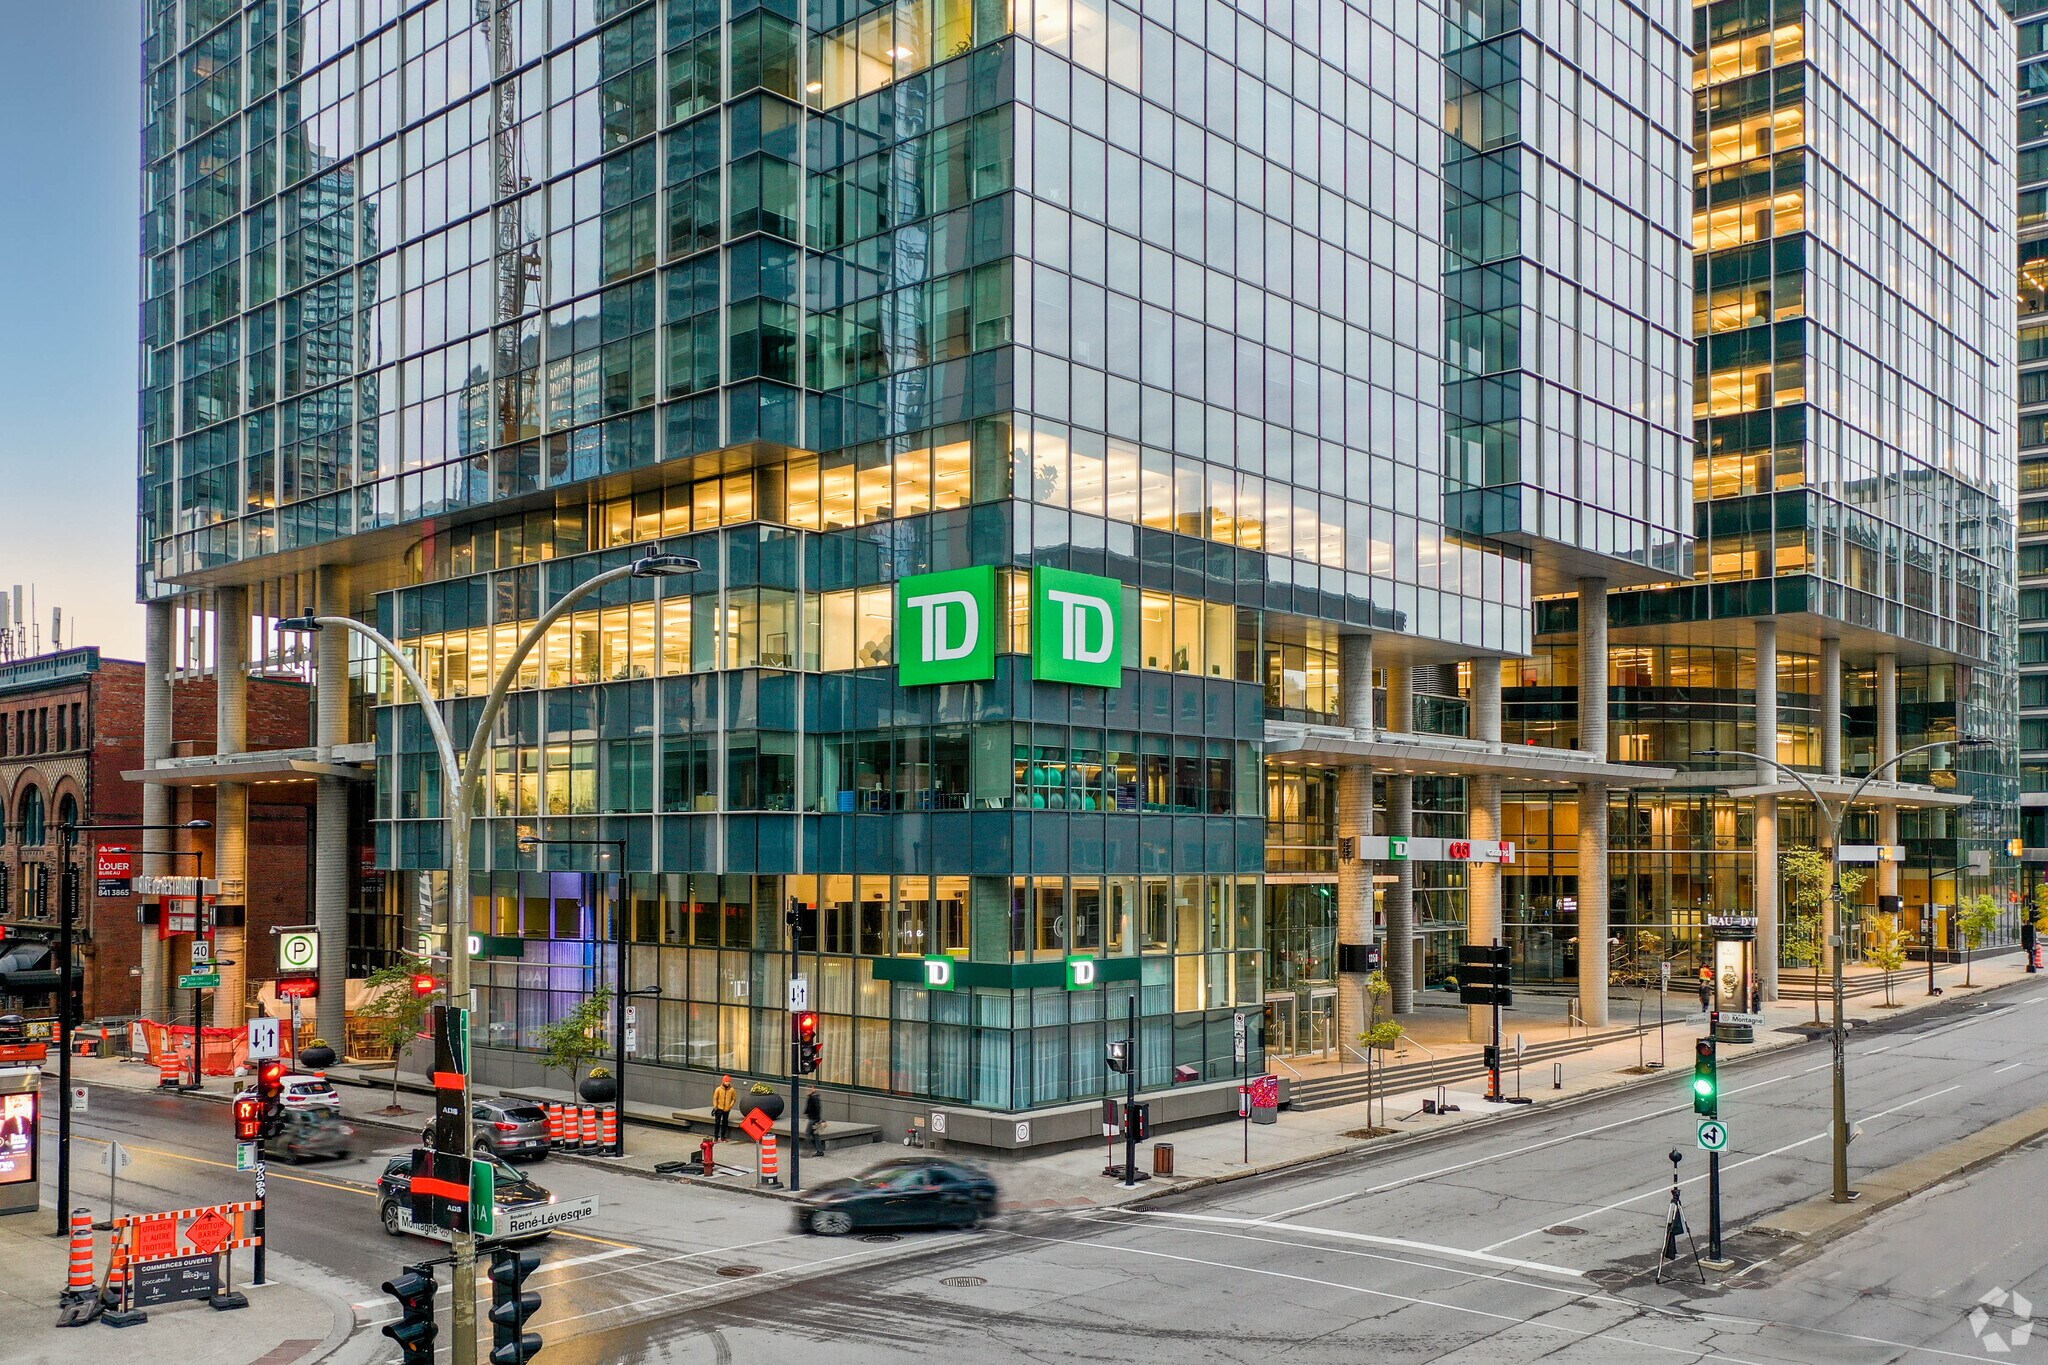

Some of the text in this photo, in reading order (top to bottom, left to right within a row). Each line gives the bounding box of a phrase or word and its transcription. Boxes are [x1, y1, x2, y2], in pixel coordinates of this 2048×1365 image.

[907, 590, 980, 663] TD
[1048, 589, 1115, 663] TD
[1449, 841, 1470, 858] CGI
[98, 862, 130, 871] LOUER
[98, 889, 111, 897] 841
[193, 945, 207, 957] 40
[293, 942, 306, 960] P
[924, 960, 950, 985] TD
[1070, 961, 1094, 985] TD
[179, 977, 188, 987] P
[1731, 1016, 1763, 1025] Montagne
[509, 1211, 532, 1220] Boulevard
[509, 1207, 592, 1232] René-Lévesque
[142, 1222, 173, 1233] UTILISER
[194, 1221, 225, 1231] TROTTOIR
[142, 1241, 173, 1252] TROTTOIR
[201, 1239, 211, 1247] 50
[141, 1256, 213, 1272] COMMERCES OUVERTS
